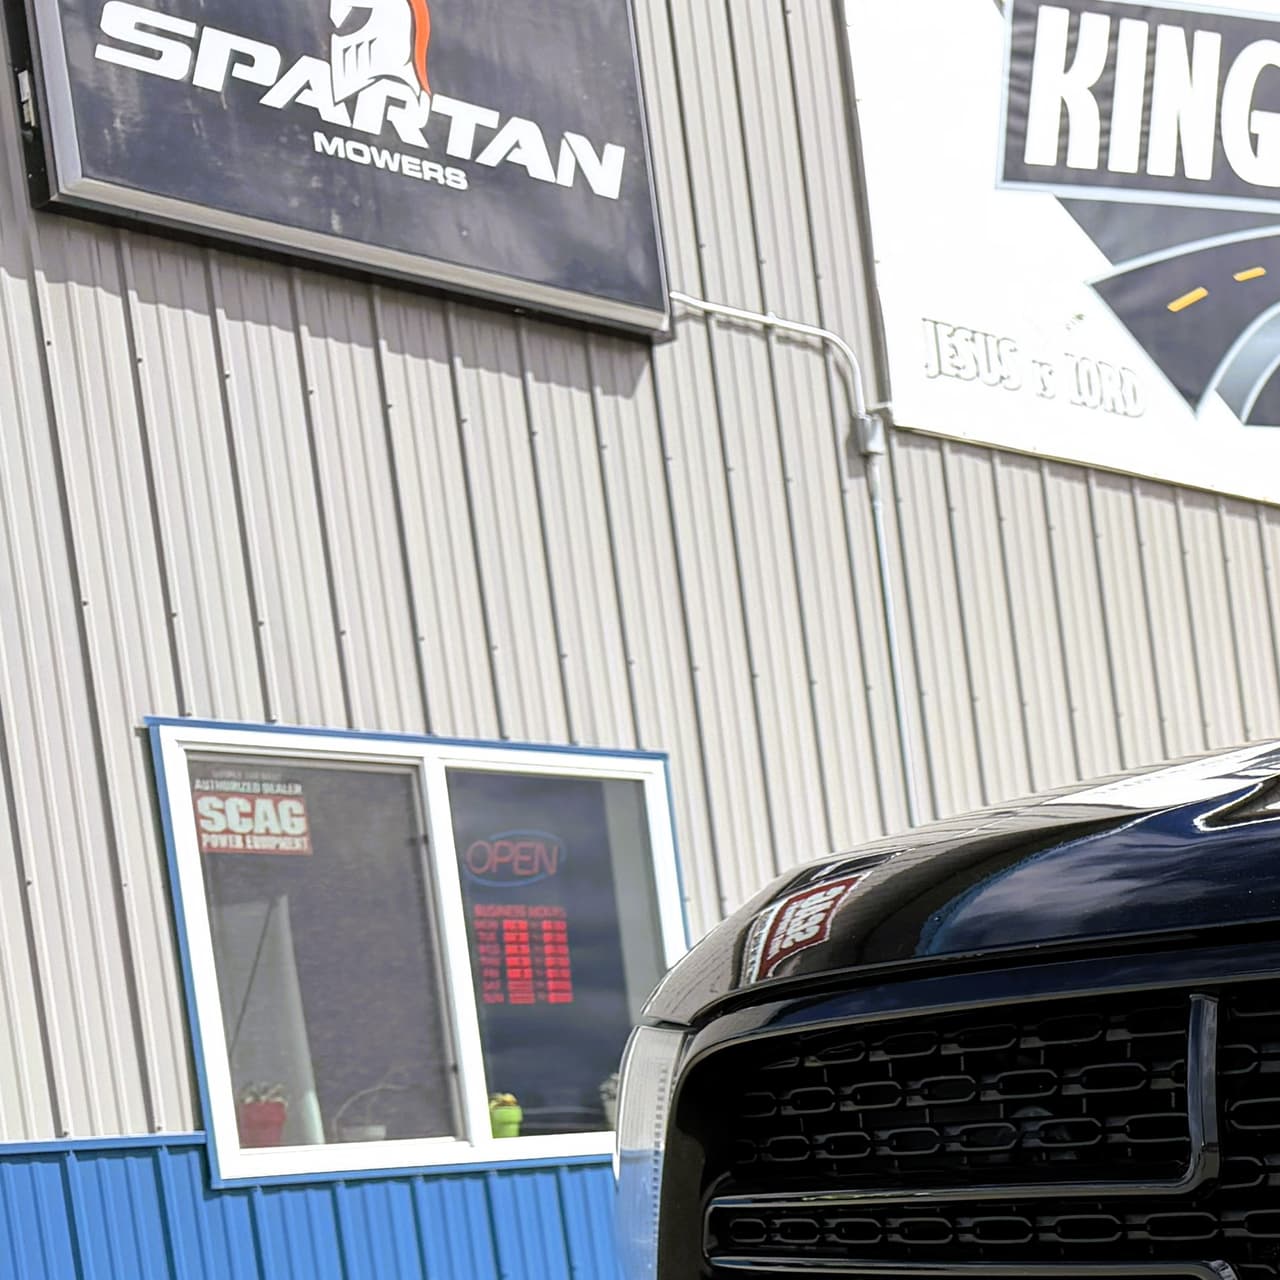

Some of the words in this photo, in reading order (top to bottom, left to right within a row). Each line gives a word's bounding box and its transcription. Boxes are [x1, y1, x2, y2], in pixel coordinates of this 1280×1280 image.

[94, 1, 626, 200] SPARTAN
[313, 131, 469, 191] MOWERS
[197, 796, 306, 836] SCAG
[466, 840, 560, 876] OPEN
